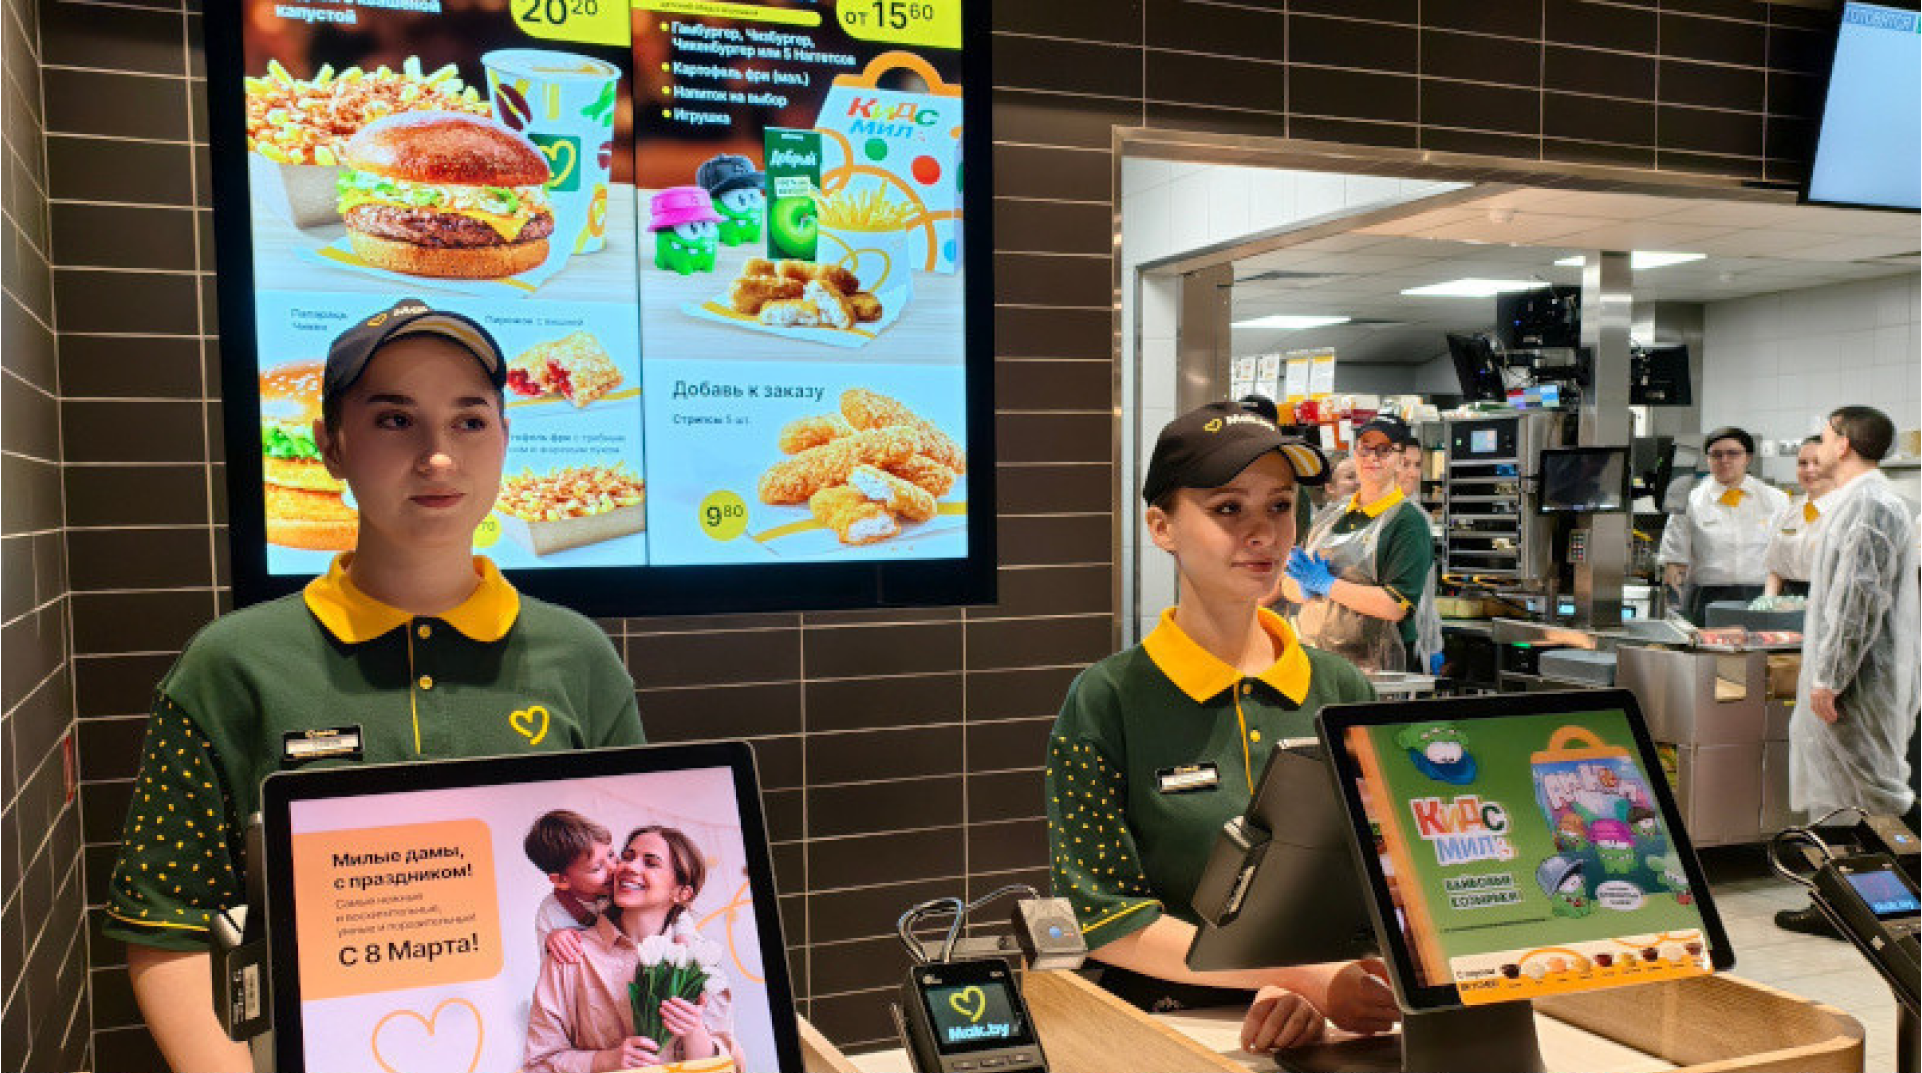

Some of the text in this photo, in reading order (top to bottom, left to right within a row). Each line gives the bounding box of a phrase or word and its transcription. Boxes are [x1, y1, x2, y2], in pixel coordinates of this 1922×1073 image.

[275, 4, 358, 24] капустой
[672, 60, 743, 80] Картофель
[745, 67, 771, 84] фри
[673, 84, 789, 109] Напиток на выбор
[673, 107, 731, 125] Игрушка
[673, 380, 825, 402] Добавь к заказу
[332, 846, 464, 868] Милые дамы,
[334, 863, 473, 890] с праздником!
[339, 933, 479, 967] С 8 Марта!
[948, 1023, 1010, 1042] Mak.by
